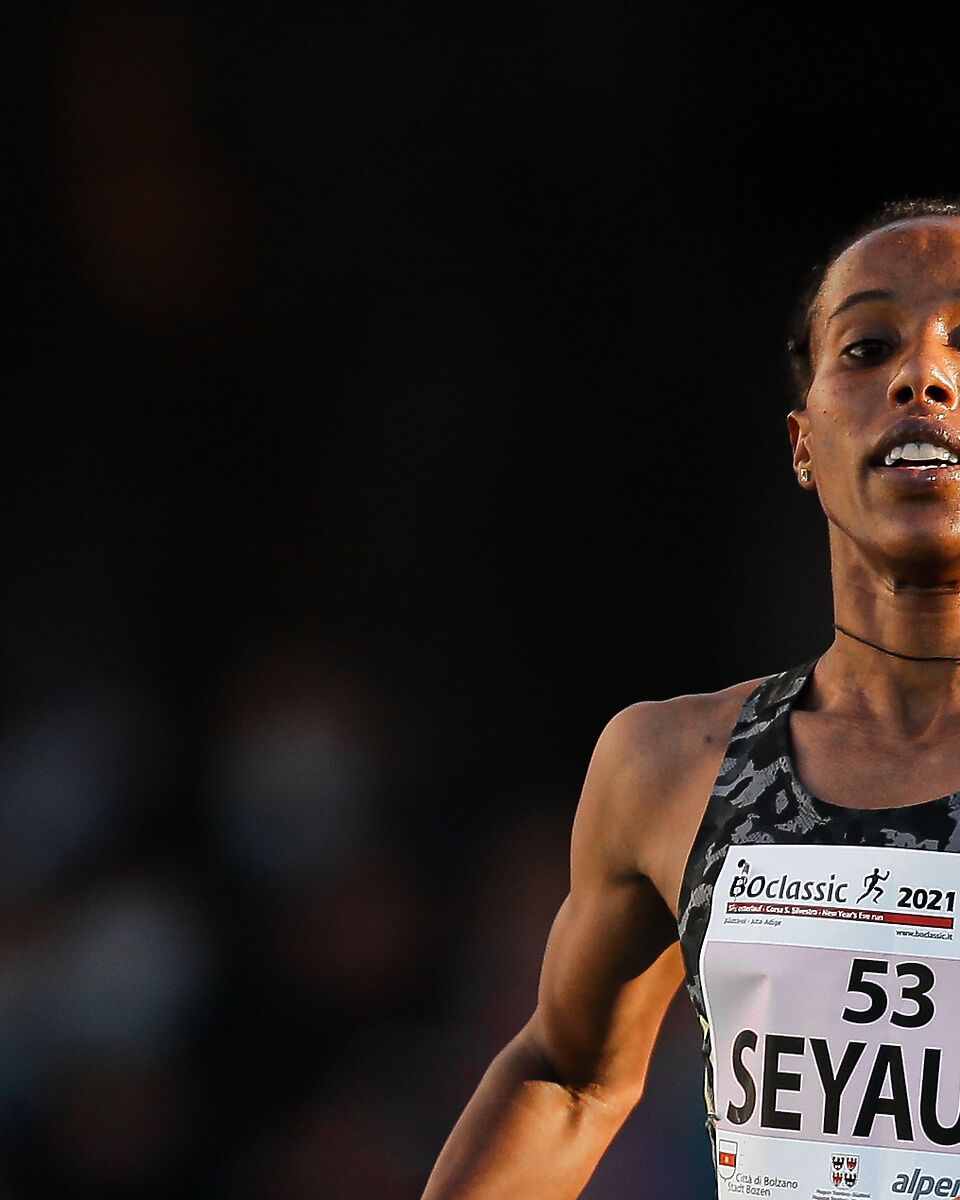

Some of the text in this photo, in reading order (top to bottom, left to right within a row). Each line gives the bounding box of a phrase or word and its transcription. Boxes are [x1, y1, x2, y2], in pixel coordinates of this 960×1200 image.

[729, 873, 956, 912] BOclassic 2021
[895, 929, 954, 941] www.boclassic.it
[841, 957, 936, 1028] 53
[728, 1181, 771, 1197] Stadt Bozen
[754, 1175, 762, 1185] di
[764, 1176, 798, 1189] Bolzano
